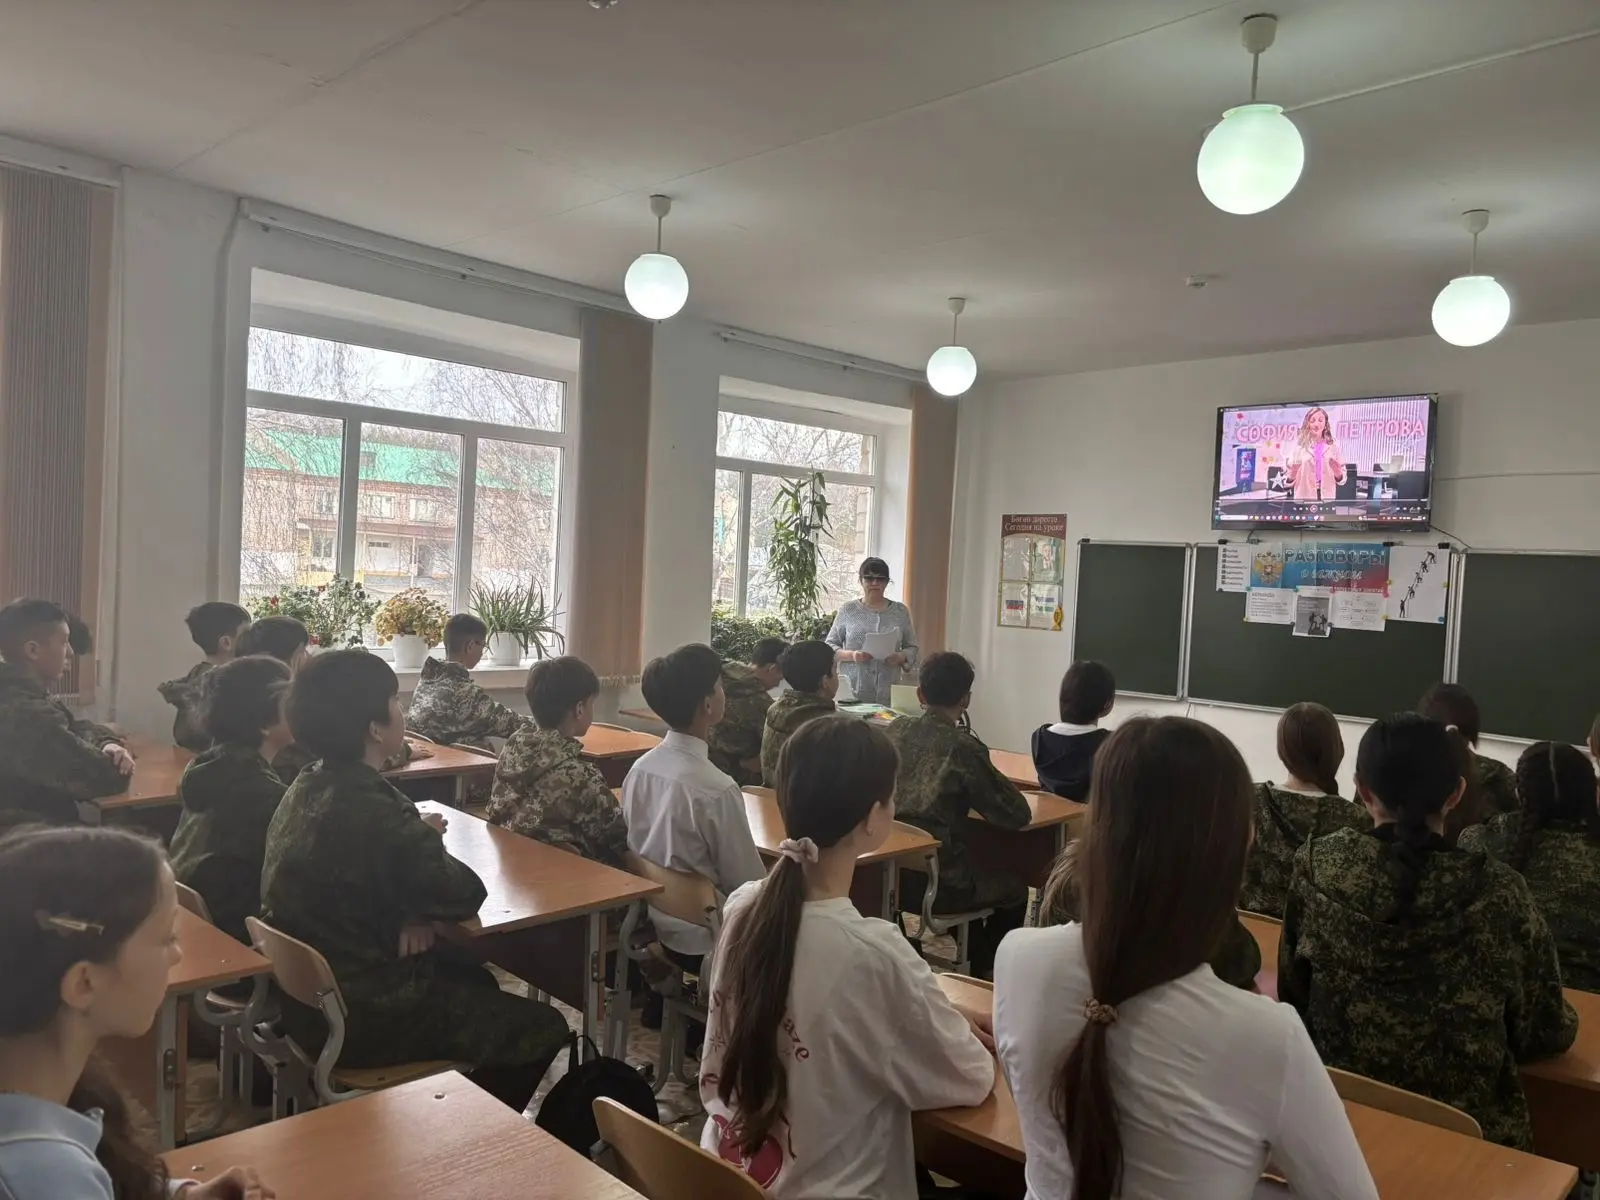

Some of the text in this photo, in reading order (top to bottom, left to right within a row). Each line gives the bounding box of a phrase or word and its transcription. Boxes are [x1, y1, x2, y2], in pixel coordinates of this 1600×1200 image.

[1236, 418, 1425, 443] СОФИЯ ПЕТРОВА
[1284, 548, 1386, 566] РАЗГОВОРЫ
